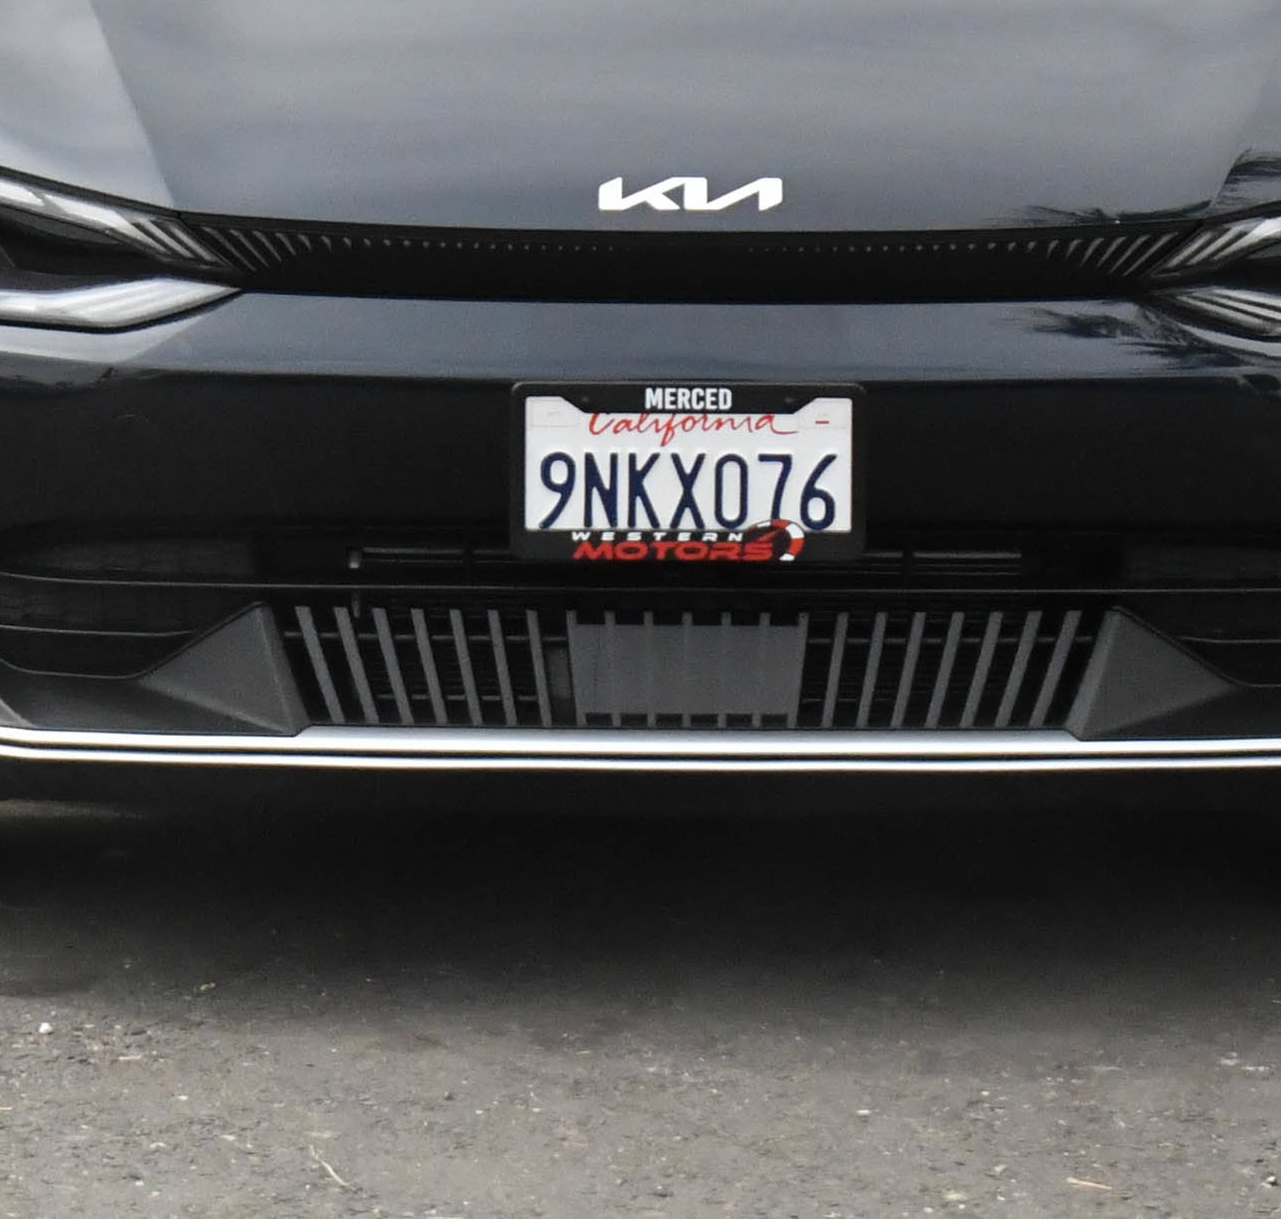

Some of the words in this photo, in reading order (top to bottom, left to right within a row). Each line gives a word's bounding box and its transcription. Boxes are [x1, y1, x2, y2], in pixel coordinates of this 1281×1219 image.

[598, 176, 783, 211] KIA
[645, 387, 733, 412] MERCED
[589, 413, 798, 447] California
[538, 452, 837, 530] 9NKX076
[571, 531, 744, 543] WESTERN
[572, 541, 774, 562] MOTORS
